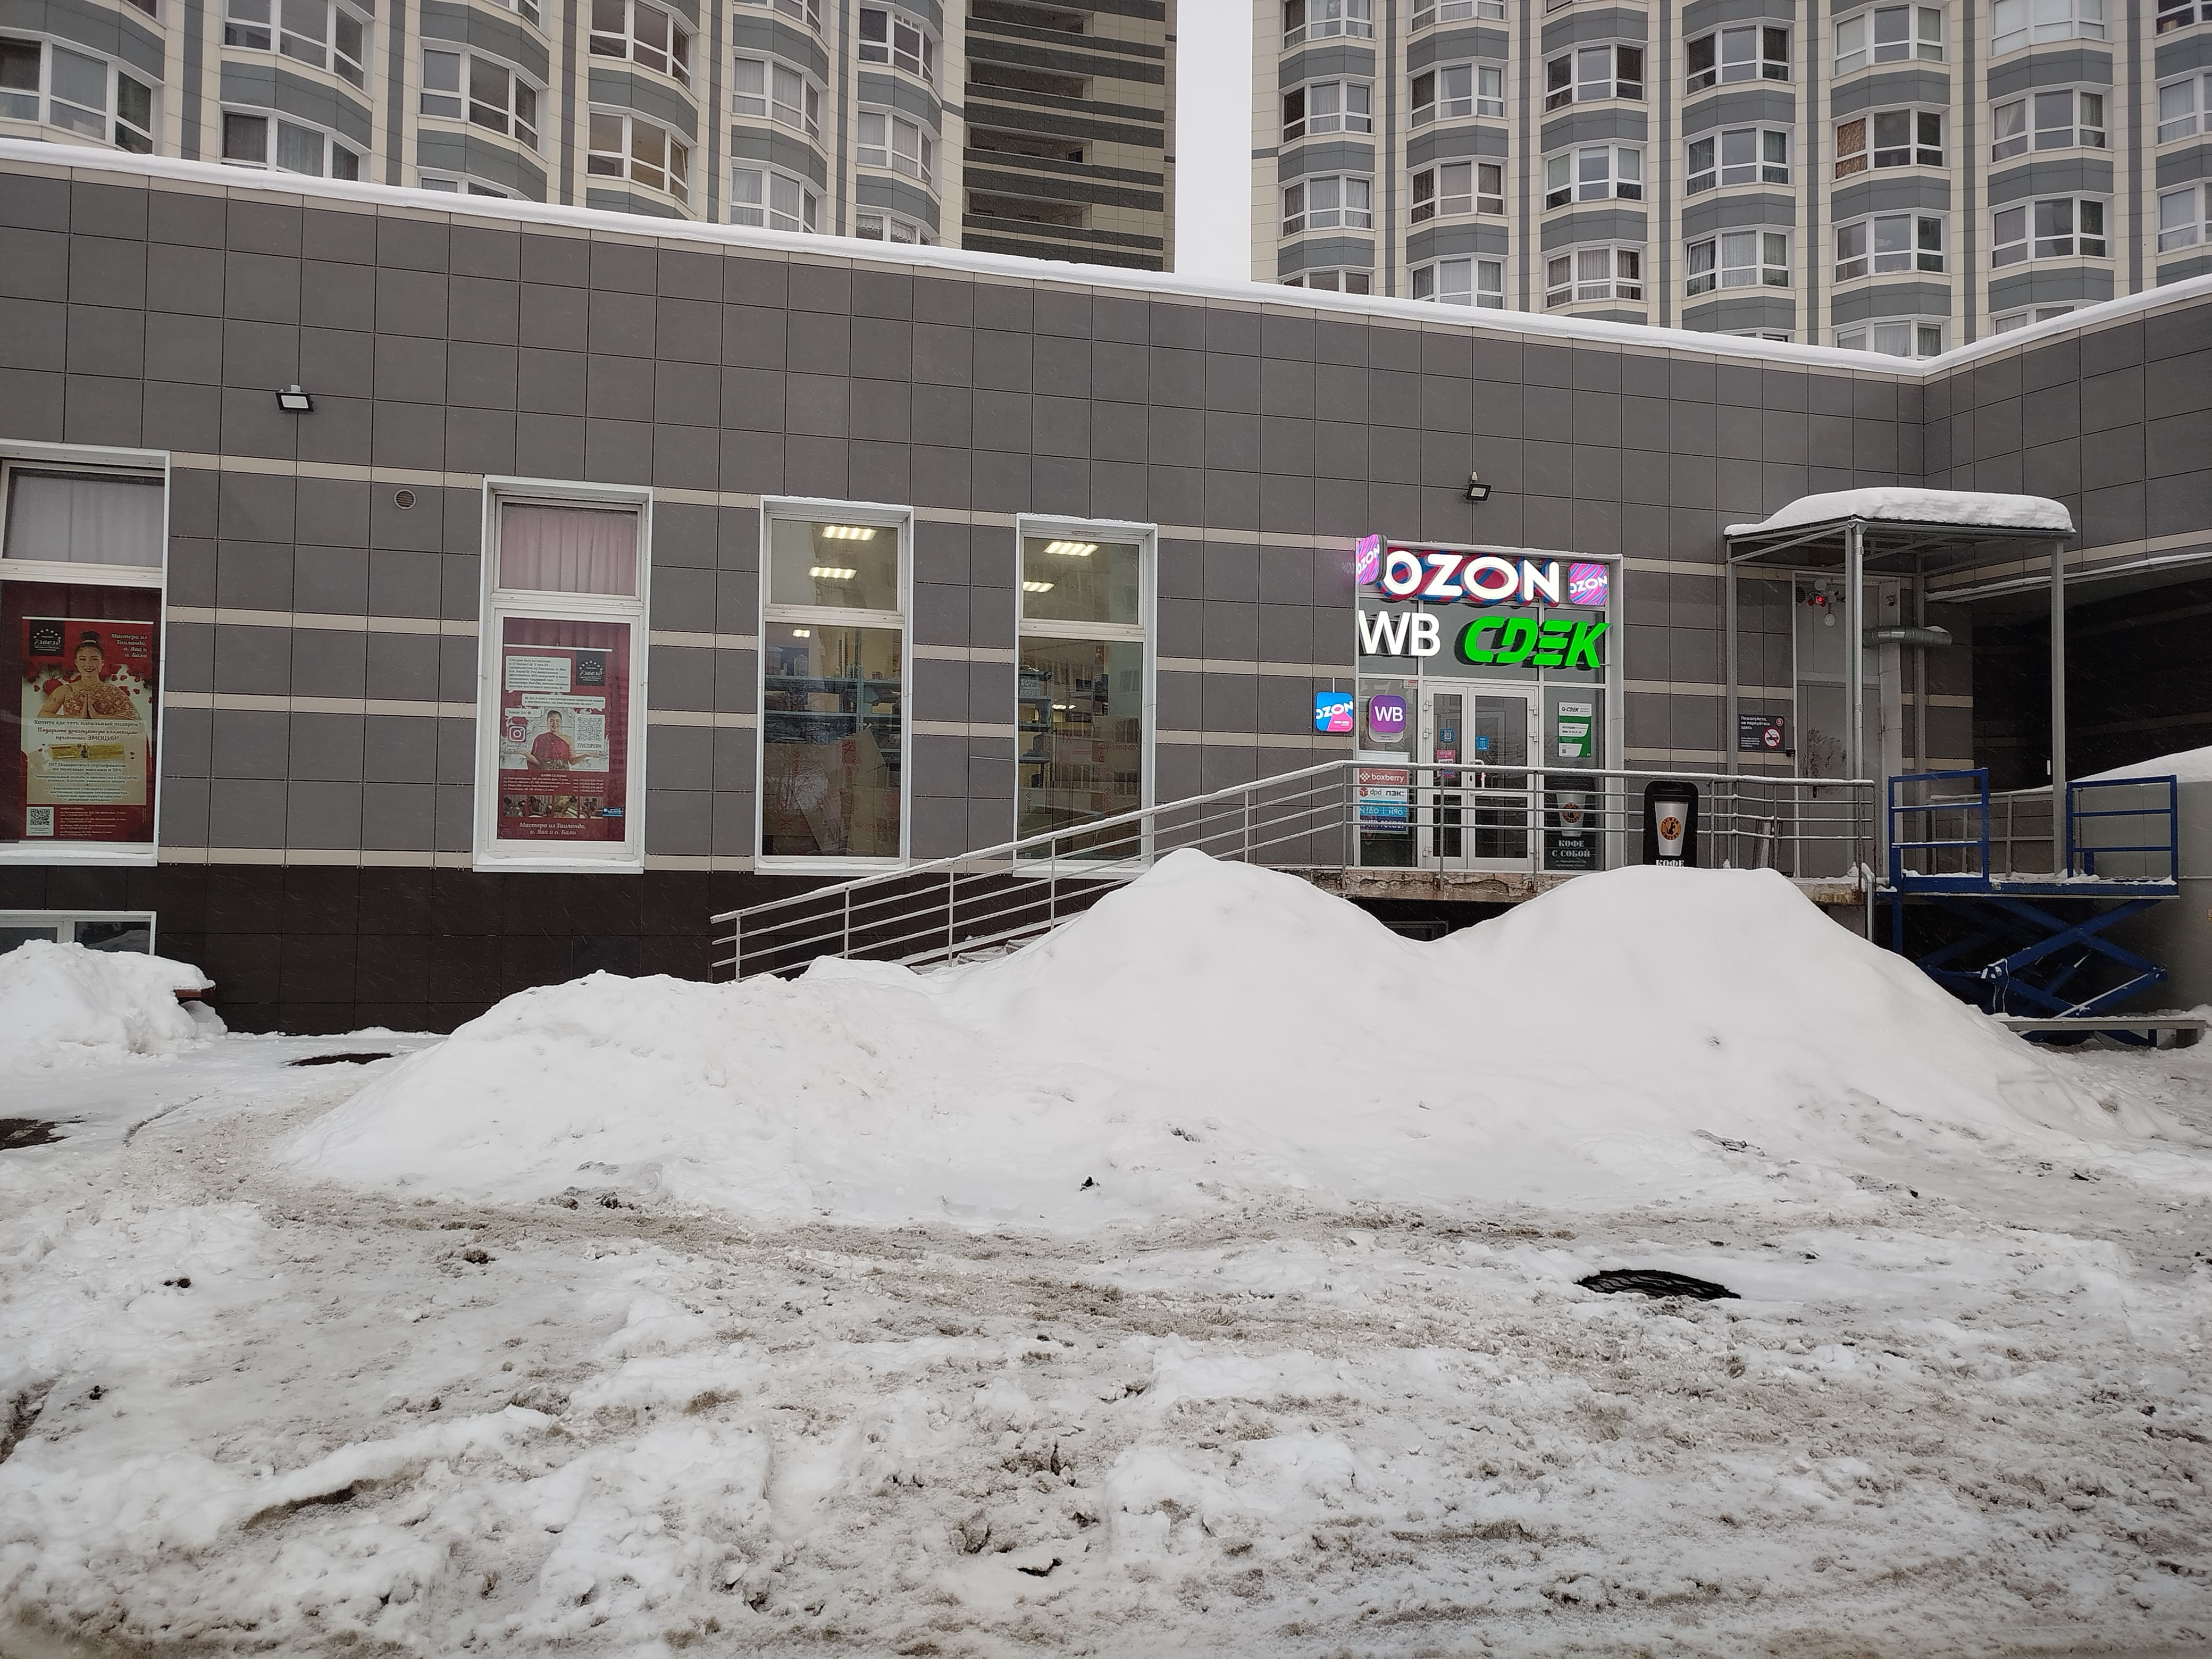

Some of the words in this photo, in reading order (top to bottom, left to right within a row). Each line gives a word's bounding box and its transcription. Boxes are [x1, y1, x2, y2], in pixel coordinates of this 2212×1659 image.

[1358, 543, 1379, 574] OZON
[1382, 549, 1560, 604] OZON
[1570, 575, 1607, 594] OZON
[1358, 610, 1440, 657] WB
[1464, 616, 1611, 668] CDEK
[1316, 701, 1353, 719] OZON
[1375, 706, 1403, 722] WB
[1371, 773, 1404, 783] boxberry
[1560, 849, 1590, 857] СОБОЙ
